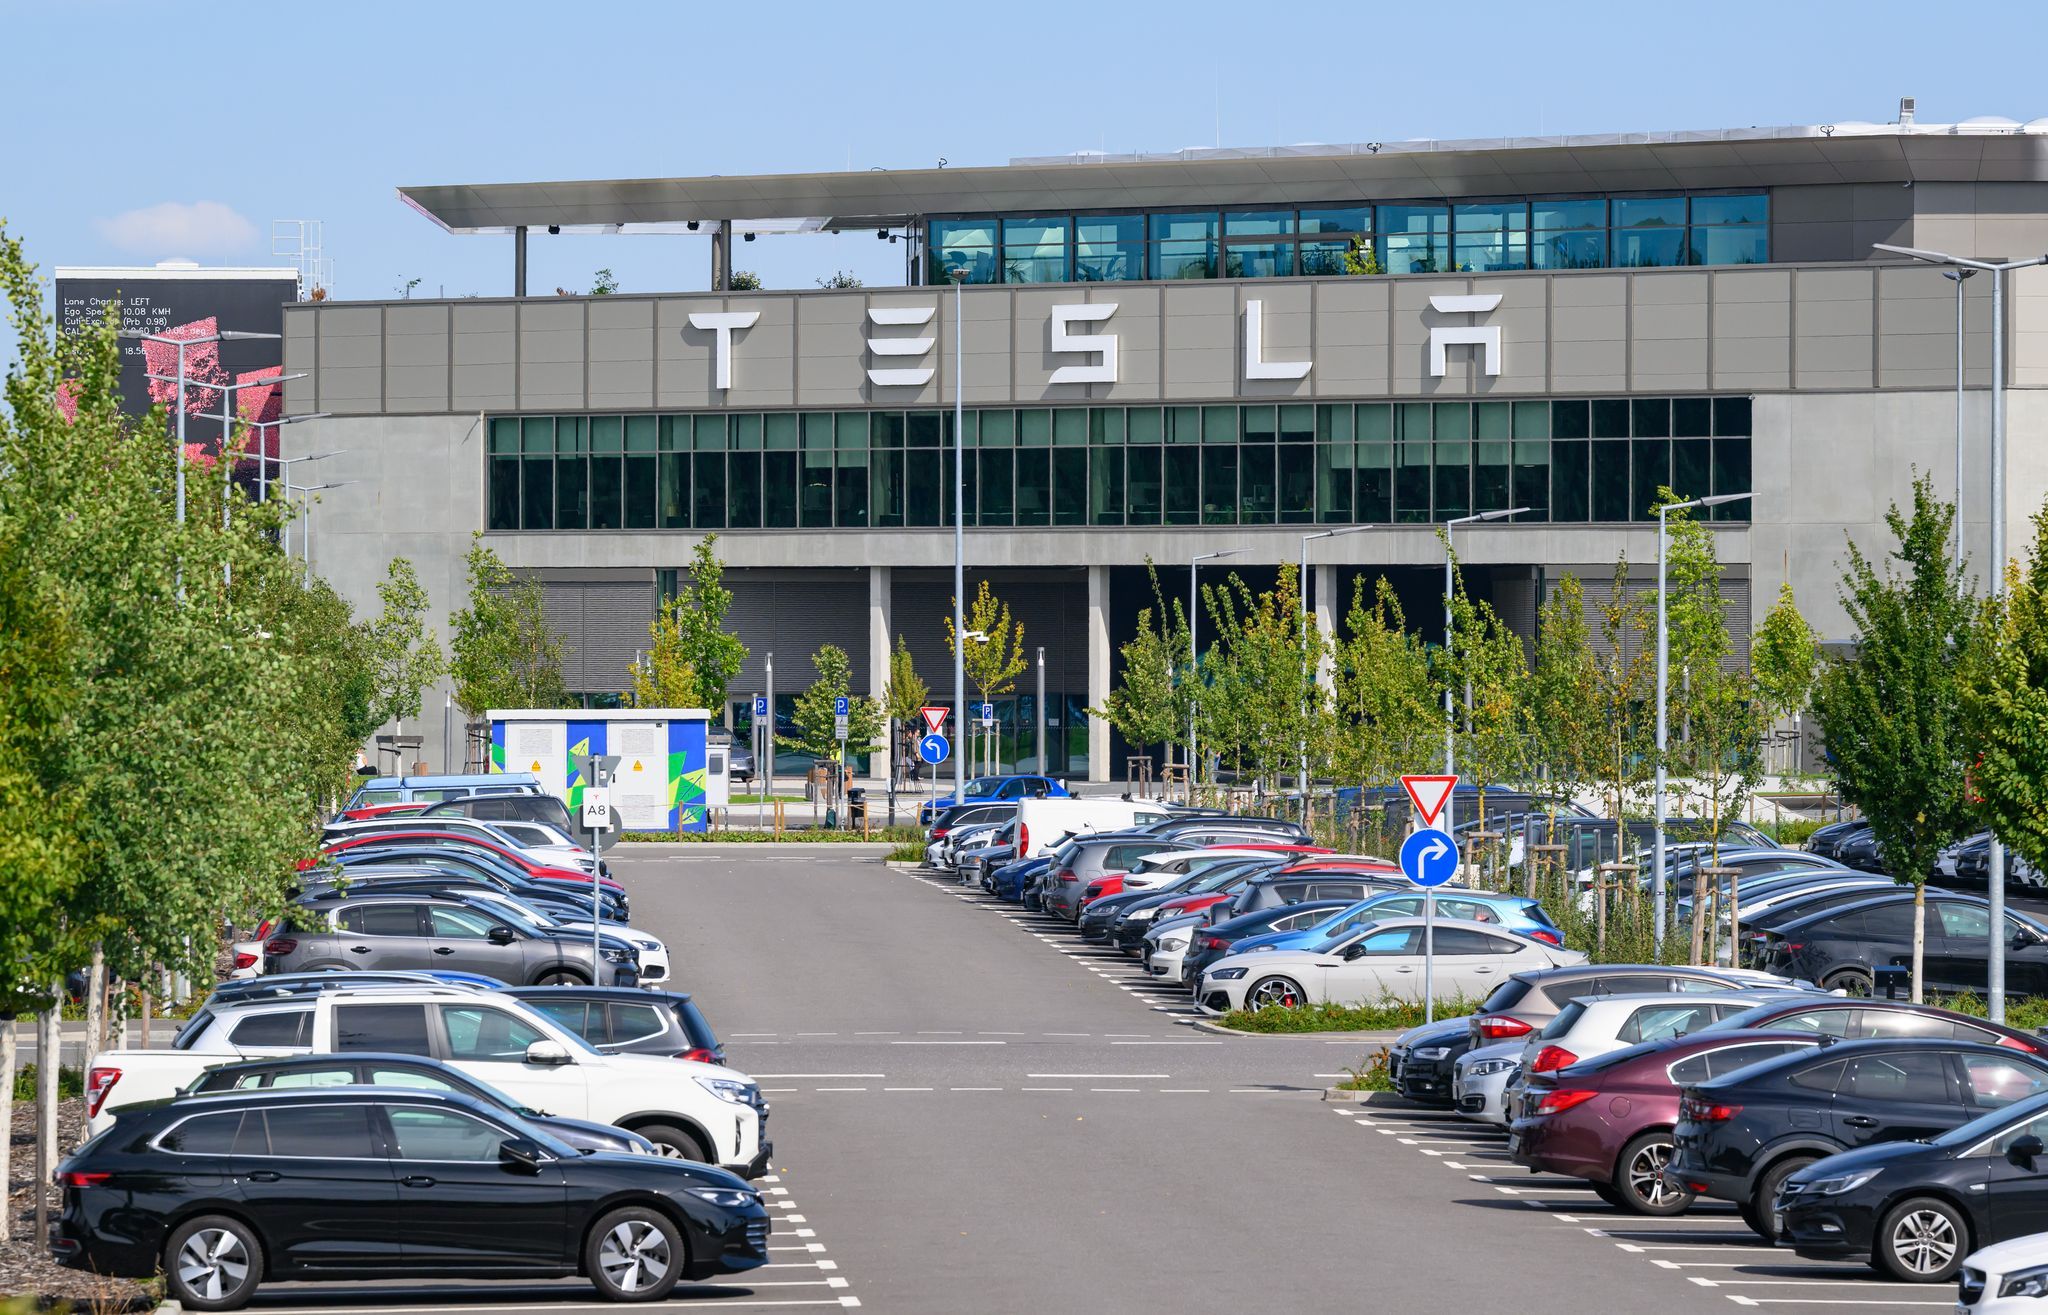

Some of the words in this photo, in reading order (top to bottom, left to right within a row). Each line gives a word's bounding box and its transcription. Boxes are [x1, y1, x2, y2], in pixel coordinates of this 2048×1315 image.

[64, 297, 85, 306] Lane
[130, 297, 150, 306] LEFT
[64, 307, 81, 317] Ego
[123, 308, 146, 316] 10.08
[152, 308, 171, 316] KMH
[123, 317, 141, 327] (Prb
[146, 317, 168, 327] 0.98)
[131, 327, 150, 335] 60
[154, 327, 161, 335] R
[190, 327, 206, 336] deg
[687, 294, 1503, 391] TESLA
[757, 699, 764, 714] P
[837, 699, 845, 714] P
[587, 805, 606, 816] A8
